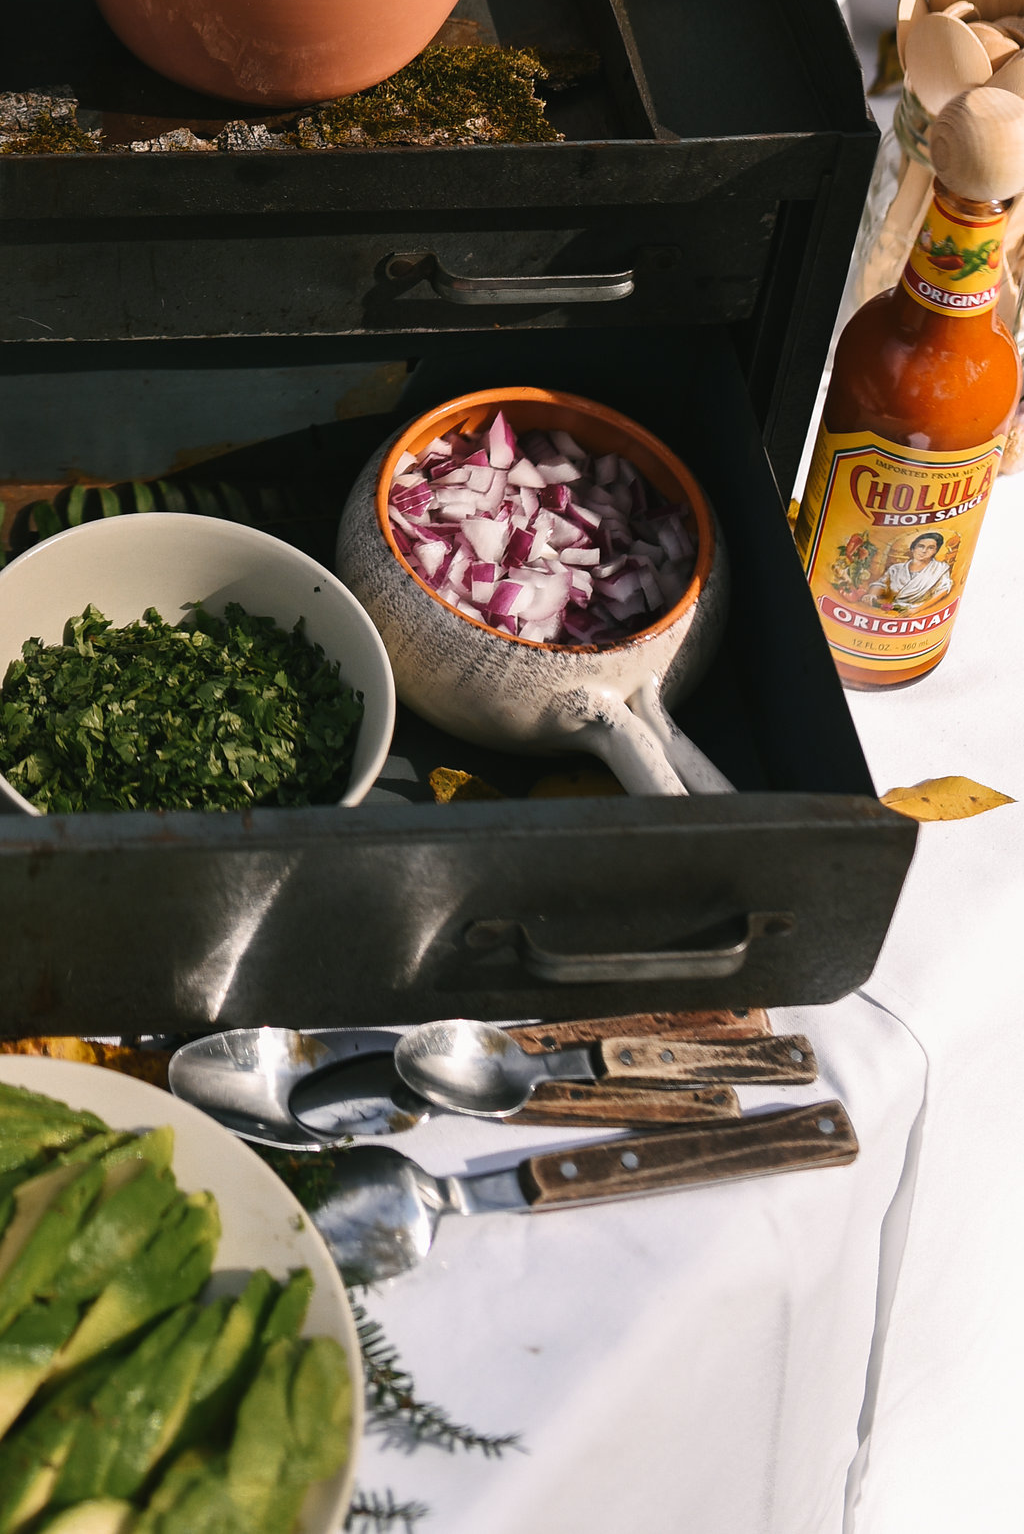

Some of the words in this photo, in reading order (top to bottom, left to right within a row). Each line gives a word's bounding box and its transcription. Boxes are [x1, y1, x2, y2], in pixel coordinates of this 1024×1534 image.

[919, 282, 996, 307] ORIGINAL
[876, 459, 928, 478] IMPORTED
[931, 472, 959, 480] FROM
[850, 464, 993, 520] CHOLULA
[883, 513, 931, 525] HOT
[934, 494, 984, 521] SAUCE
[833, 606, 951, 633] ORIGINAL
[852, 638, 862, 646] 12
[901, 642, 917, 650] 360
